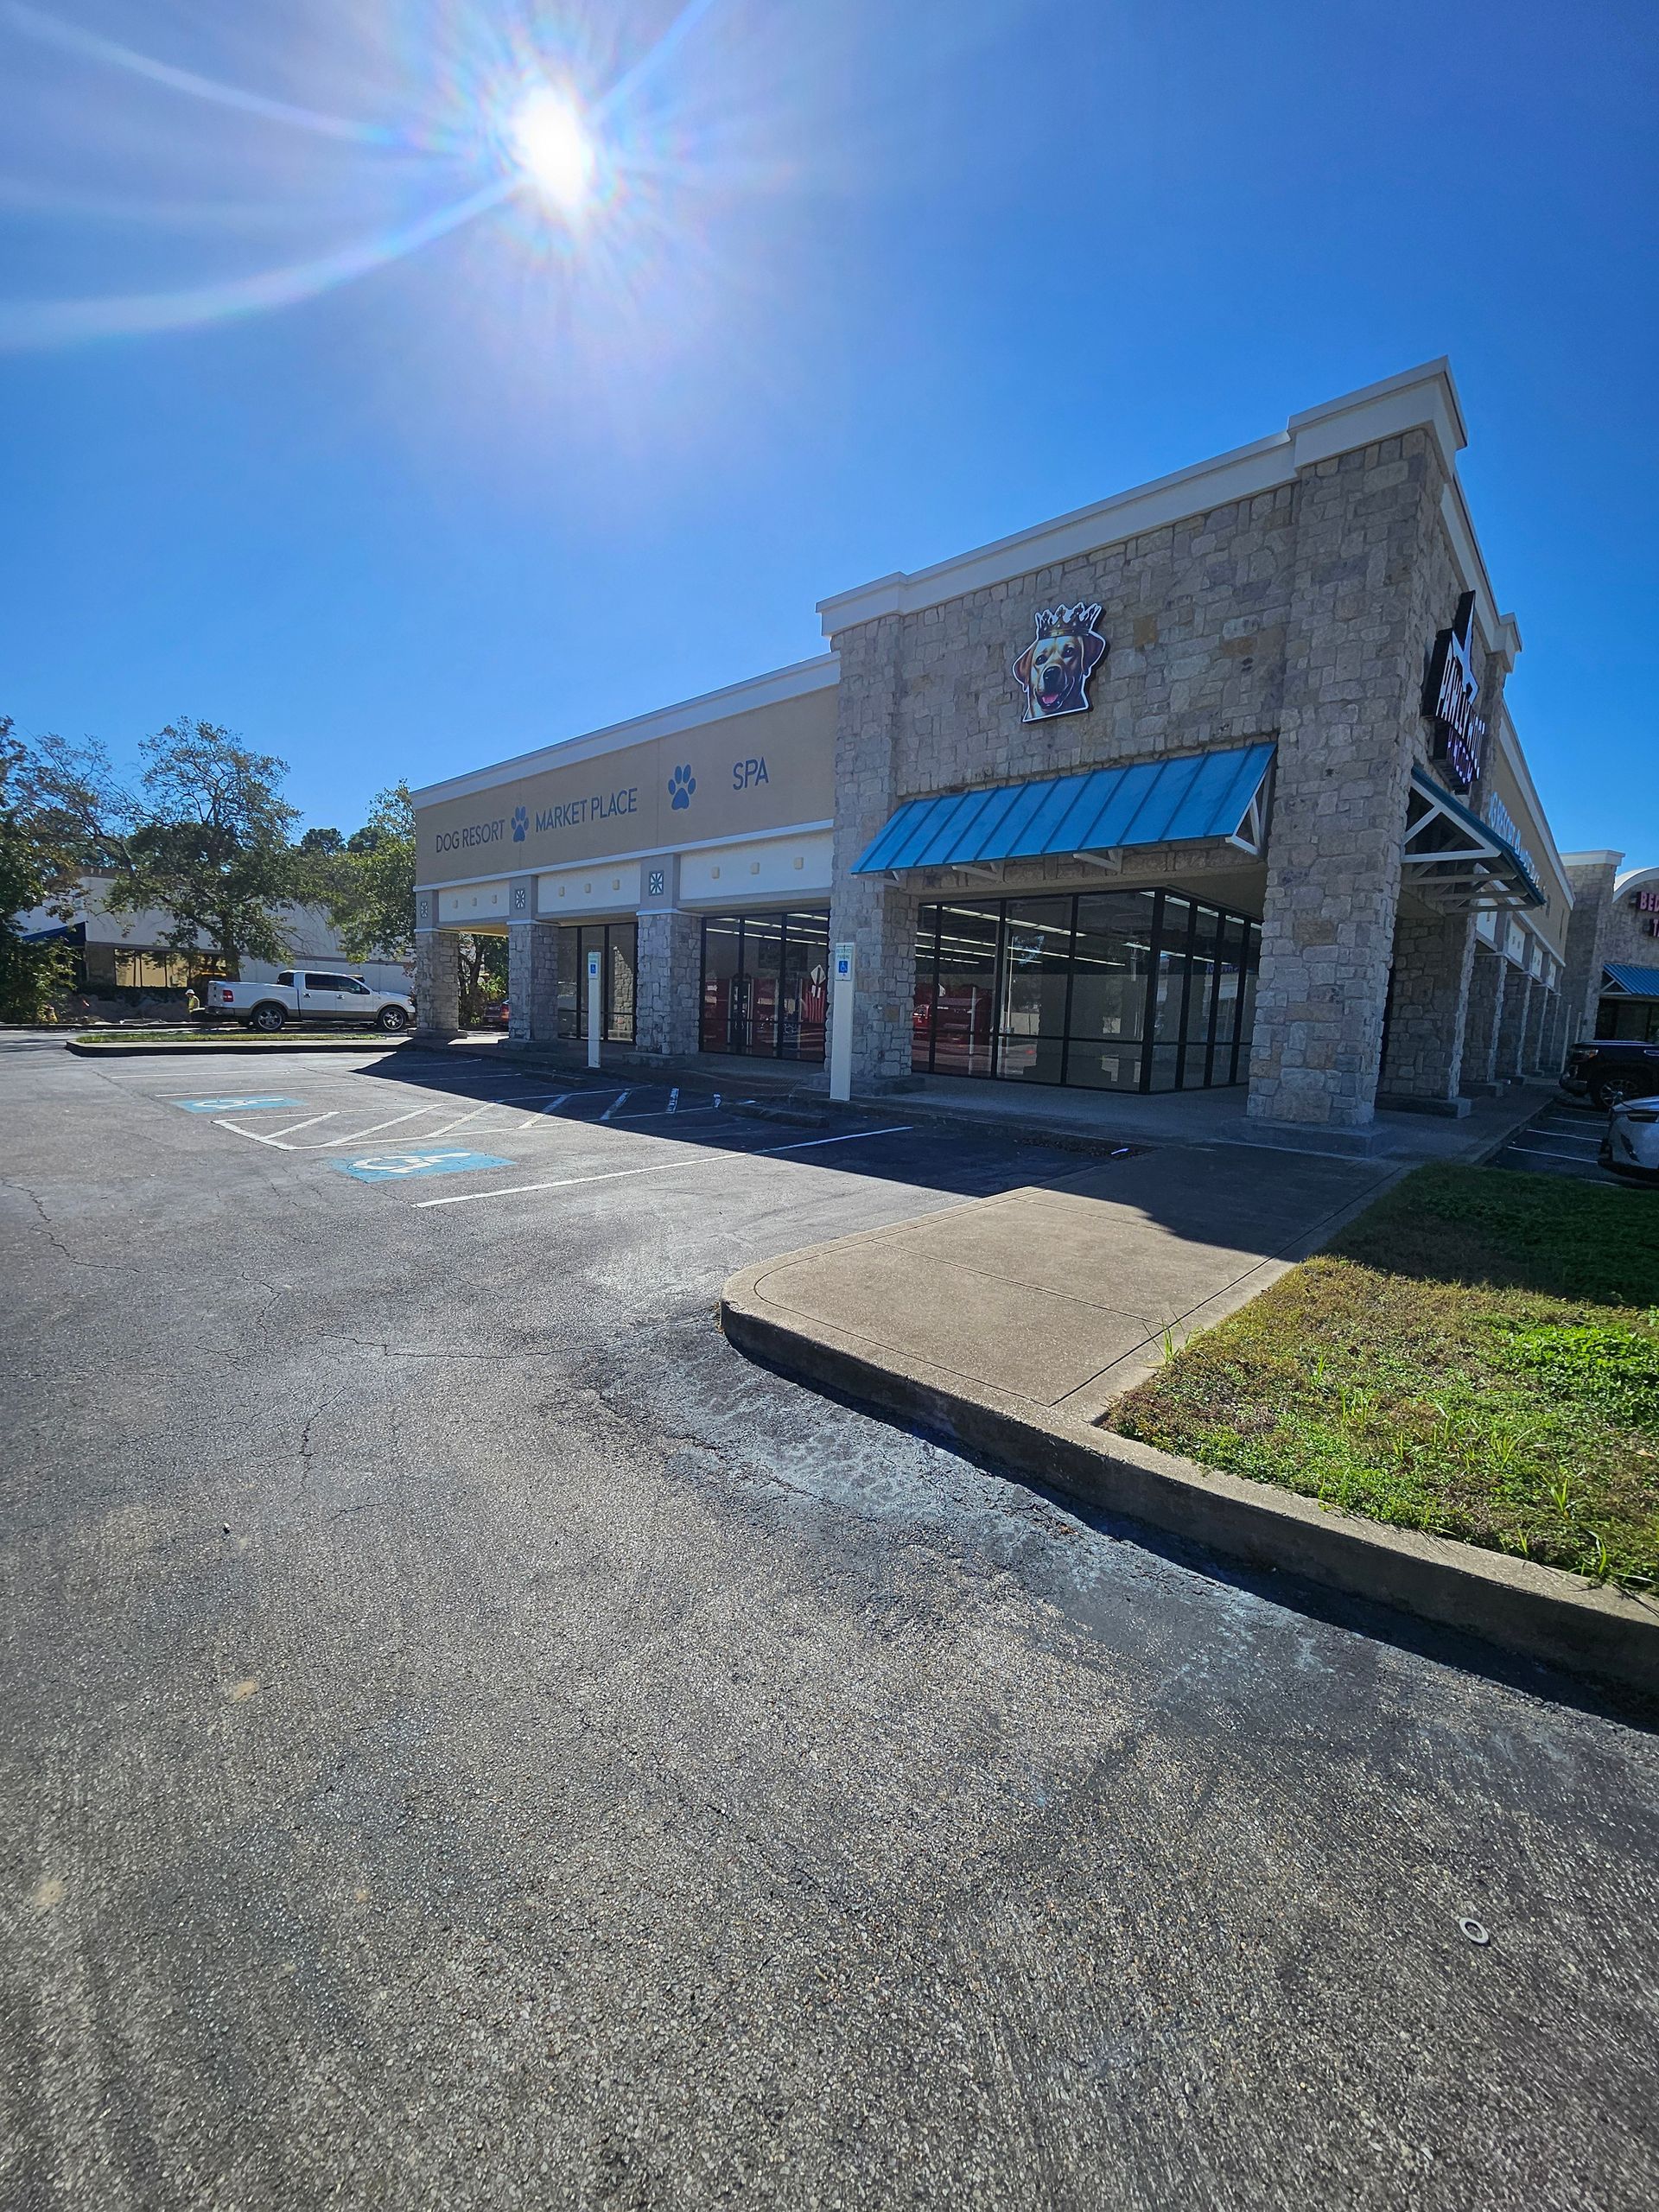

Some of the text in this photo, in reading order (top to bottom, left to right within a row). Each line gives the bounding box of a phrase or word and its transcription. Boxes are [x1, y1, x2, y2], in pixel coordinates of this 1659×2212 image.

[733, 756, 769, 791] SPA
[536, 787, 638, 832] MARKET PLACE
[435, 819, 505, 853] DOG RESORT
